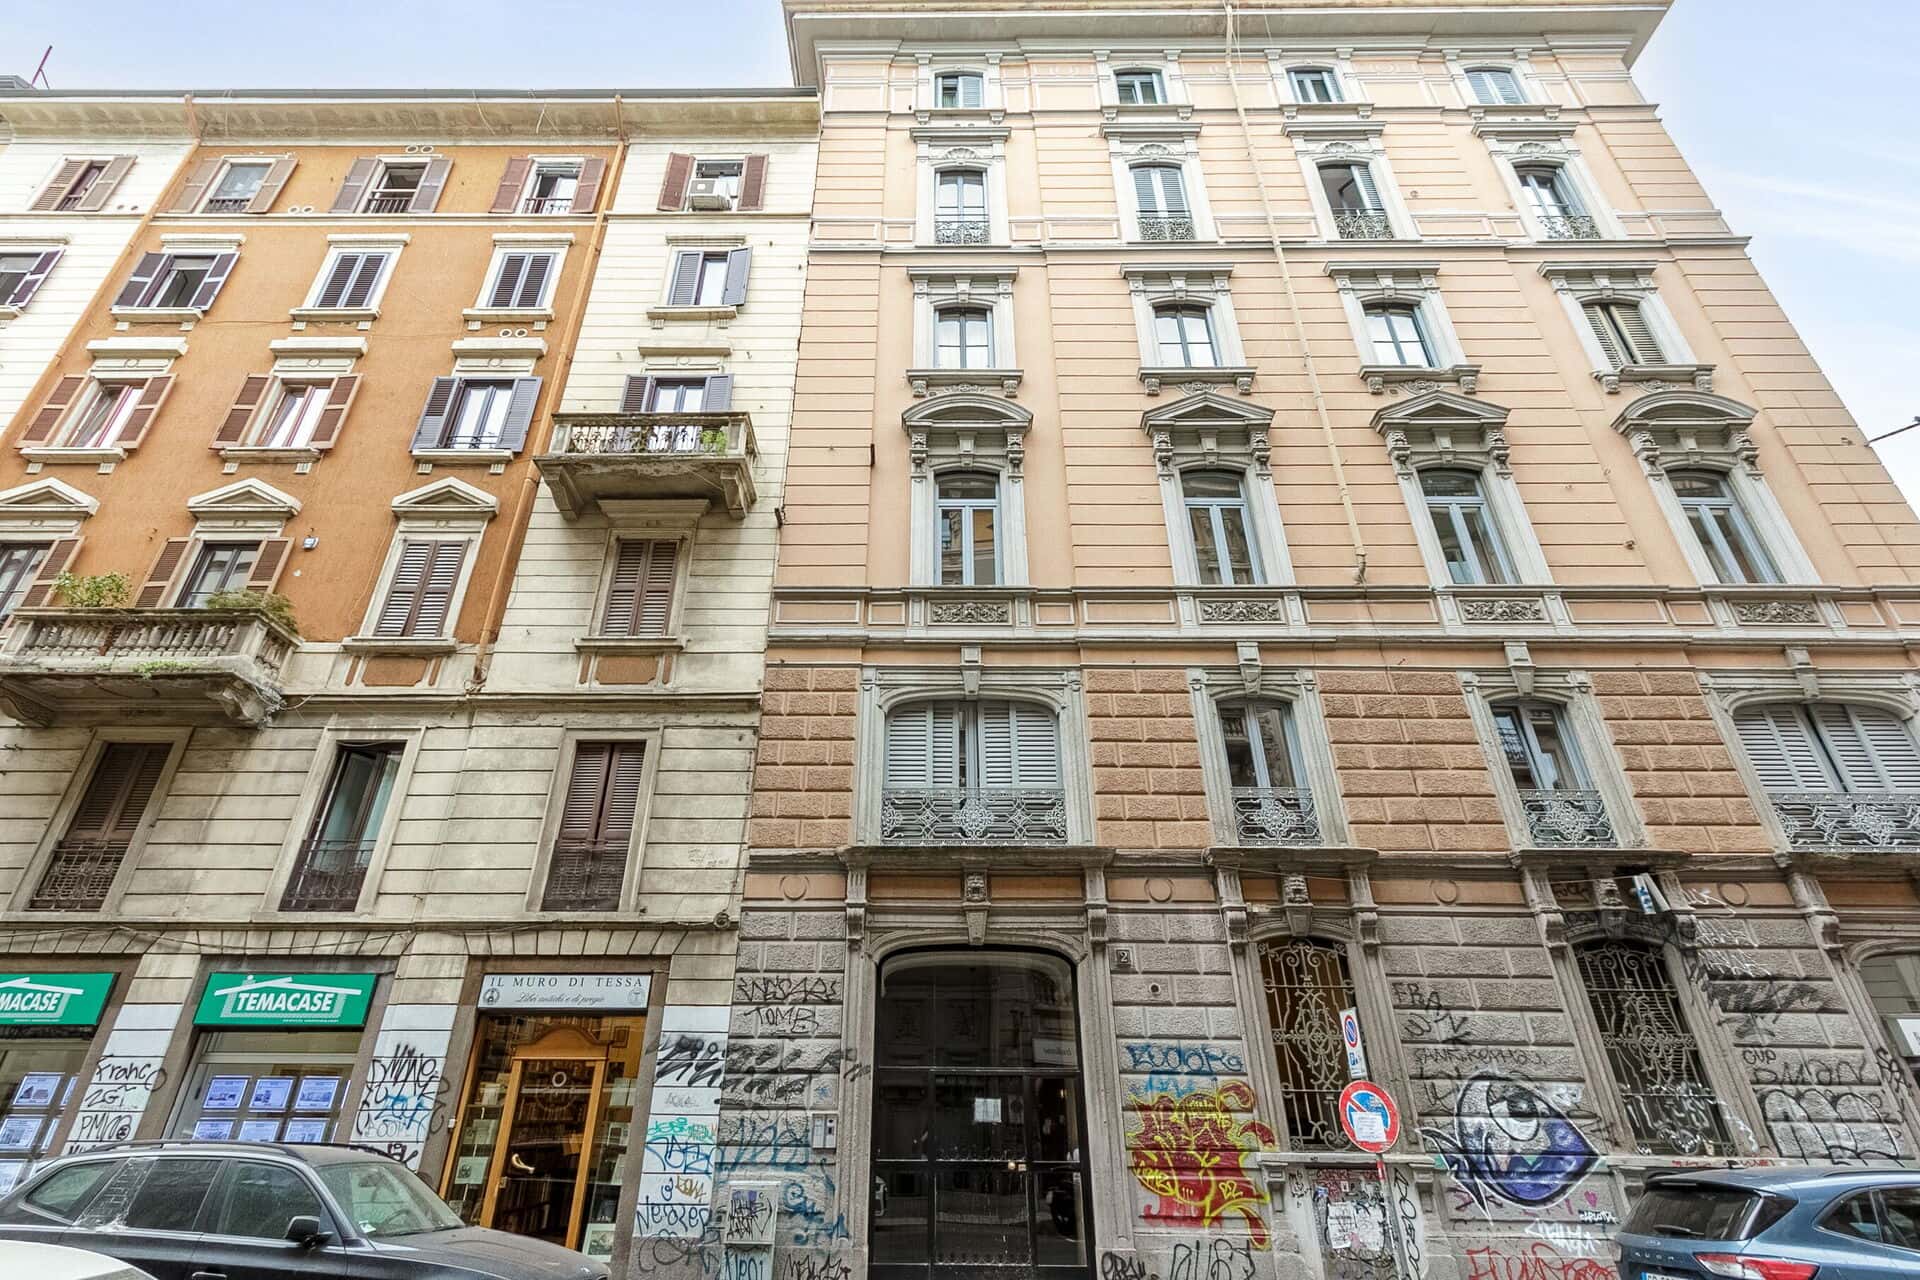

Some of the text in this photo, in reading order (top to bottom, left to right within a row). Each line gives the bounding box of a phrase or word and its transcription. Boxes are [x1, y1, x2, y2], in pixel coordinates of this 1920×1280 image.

[1119, 951, 1129, 963] 2
[490, 977, 643, 987] IL MURO DI TESSA
[236, 992, 335, 1012] TEMACASE
